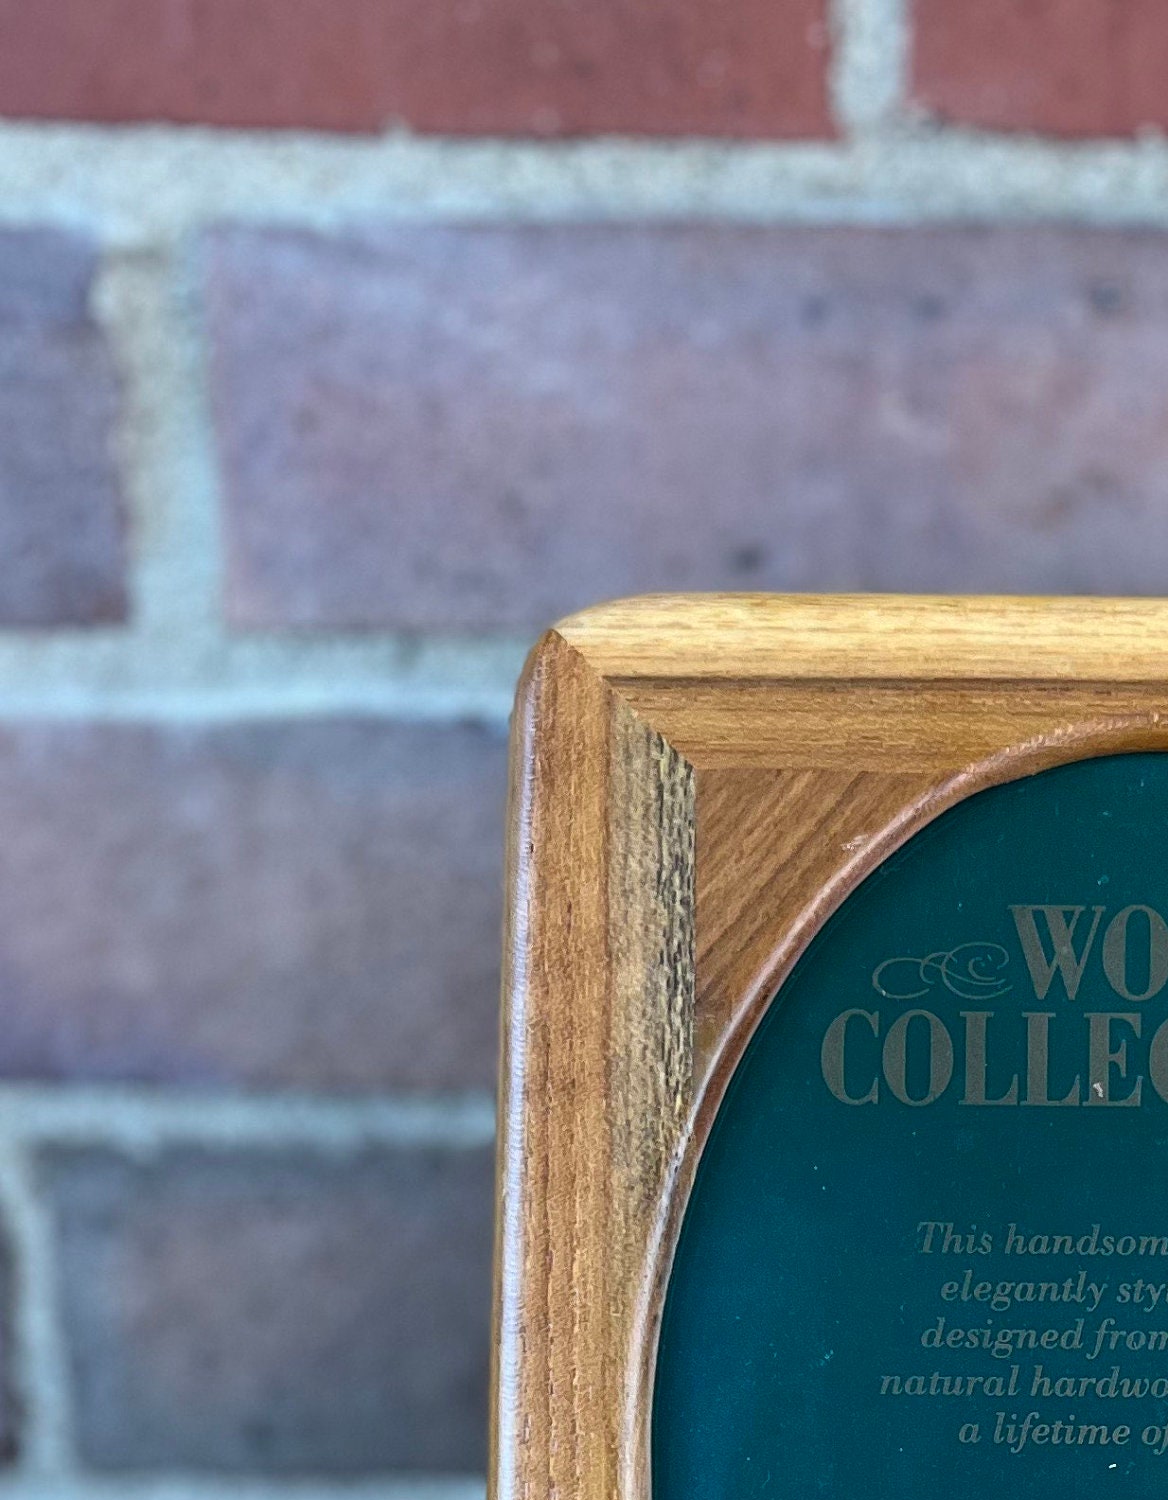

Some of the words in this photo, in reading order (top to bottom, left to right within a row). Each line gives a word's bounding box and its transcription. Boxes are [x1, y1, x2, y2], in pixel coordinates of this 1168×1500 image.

[916, 1221, 993, 1254] This
[940, 1269, 1108, 1312] elegantly
[920, 1316, 1084, 1359] designed
[879, 1364, 1020, 1397] natural
[957, 1422, 982, 1444] a
[992, 1411, 1131, 1454] lifetime
